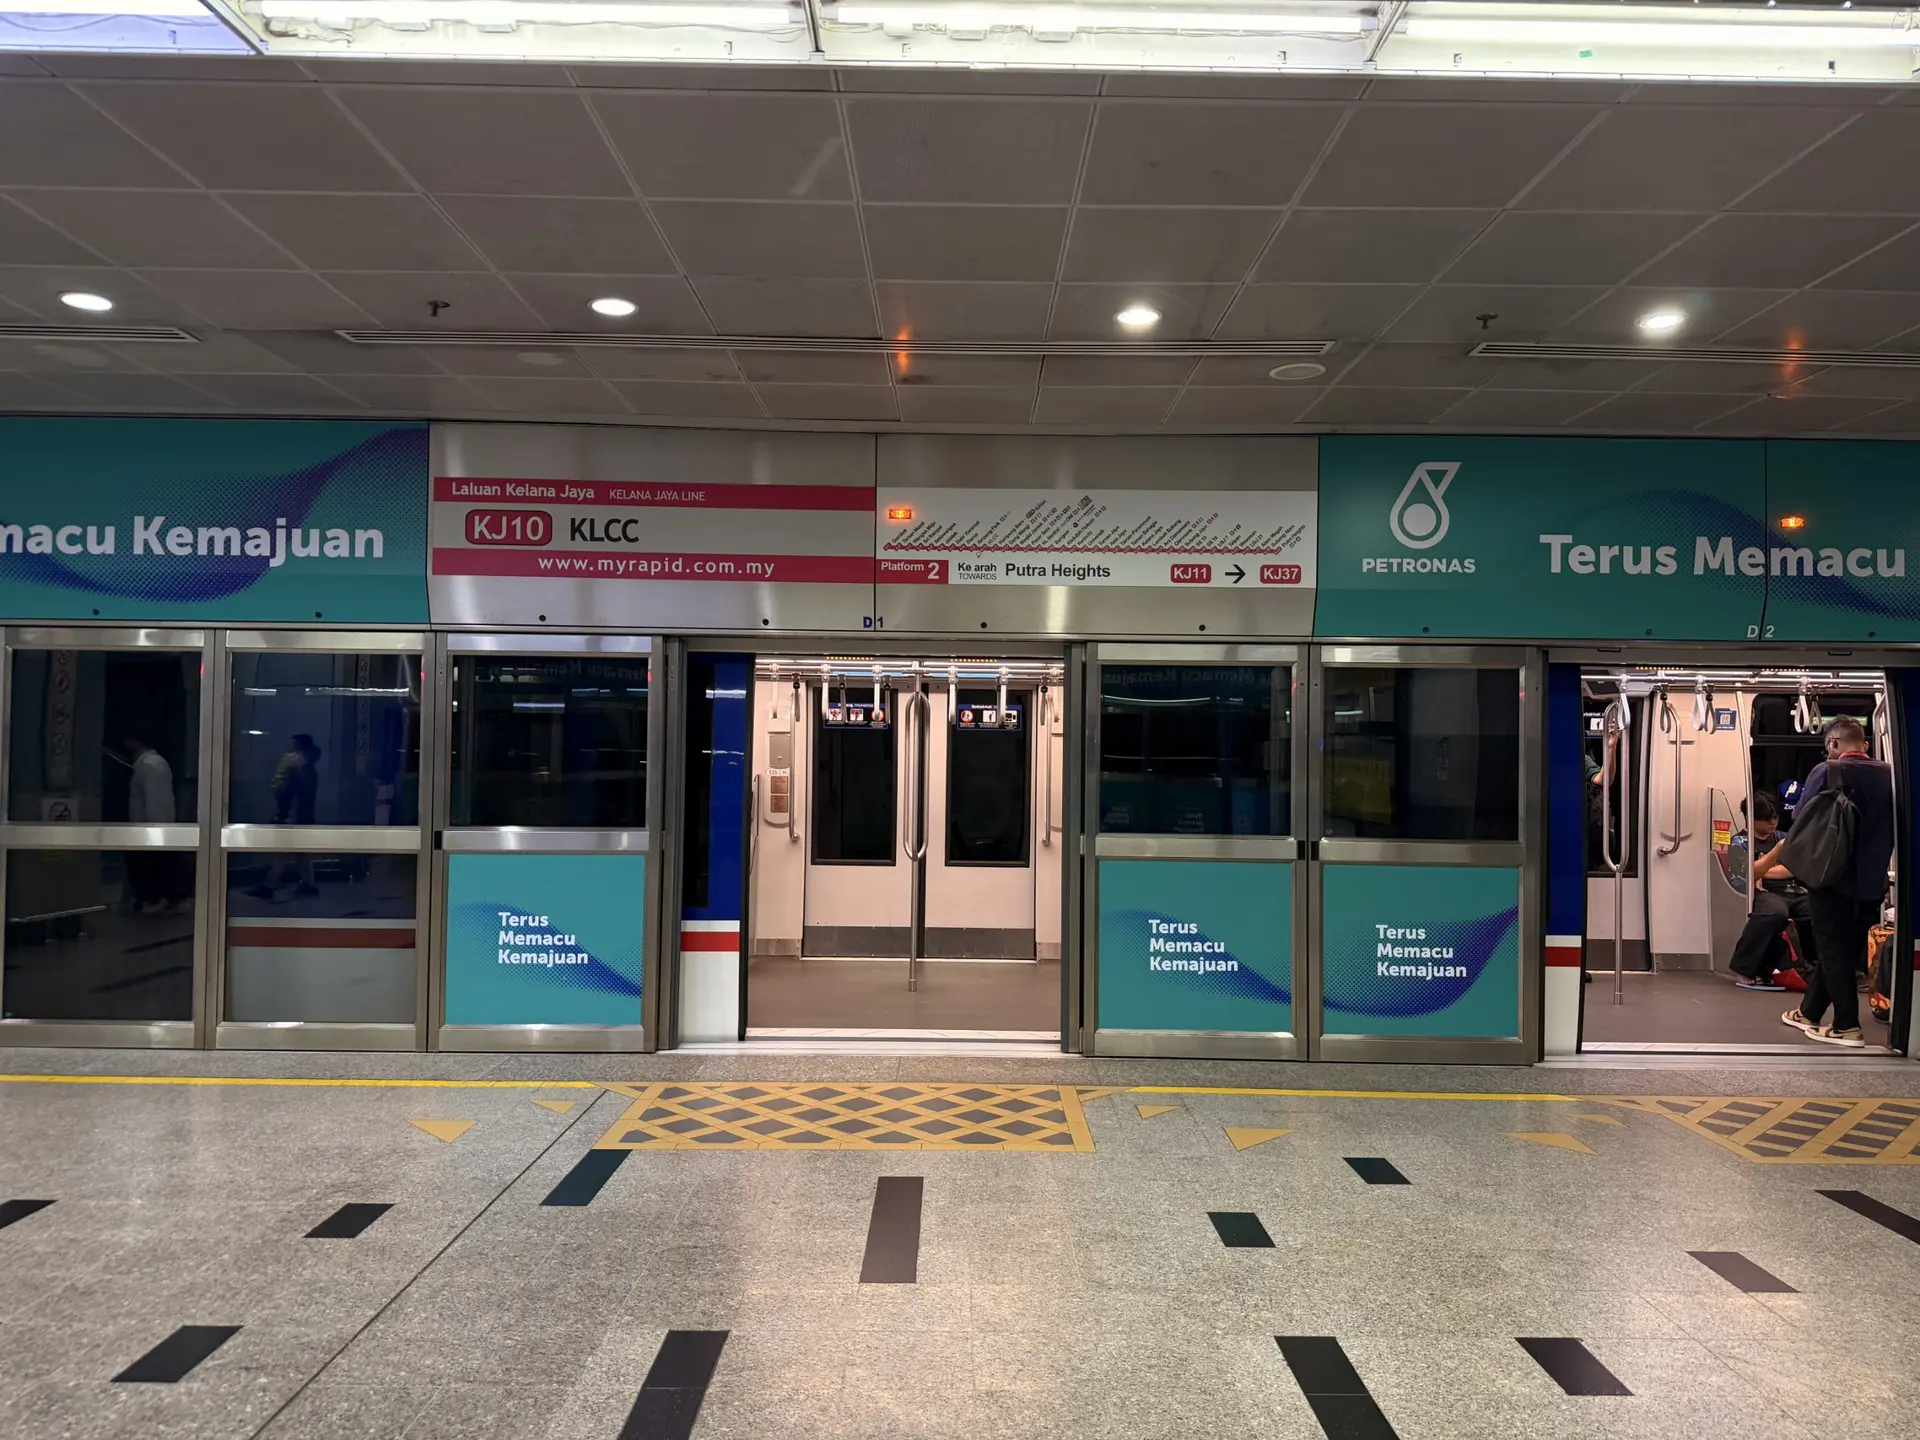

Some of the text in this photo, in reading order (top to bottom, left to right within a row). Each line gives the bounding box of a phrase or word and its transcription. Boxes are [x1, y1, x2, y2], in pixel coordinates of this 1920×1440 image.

[452, 482, 594, 500] Laluan Kelana Jaya
[610, 489, 706, 501] KELANA JAYA LINE
[474, 515, 640, 543] KJ10 KLCC
[133, 516, 384, 567] Kemajuan
[1539, 534, 1906, 577] Terus Memacu
[538, 556, 774, 578] www.myrapid.com.my
[881, 561, 940, 580] Platform 2
[958, 562, 996, 572] Ke arah
[1006, 562, 1110, 580] Putra Heights
[1174, 567, 1207, 580] KJ11
[1263, 568, 1299, 580] KJ37
[1362, 558, 1476, 574] PETRONAS
[959, 572, 997, 580] TOWARDS
[863, 616, 884, 628] D 1
[1747, 625, 1775, 638] D 2
[498, 912, 548, 926] Terus
[1149, 920, 1198, 934] Terus
[498, 930, 576, 946] Memacu
[1376, 924, 1426, 940] Terus
[1150, 938, 1224, 952] Memacu
[1377, 943, 1453, 958] Memacu
[498, 949, 588, 968] Kemajuan
[1150, 956, 1238, 974] Kemajuan
[1377, 962, 1467, 980] Kemajuan
